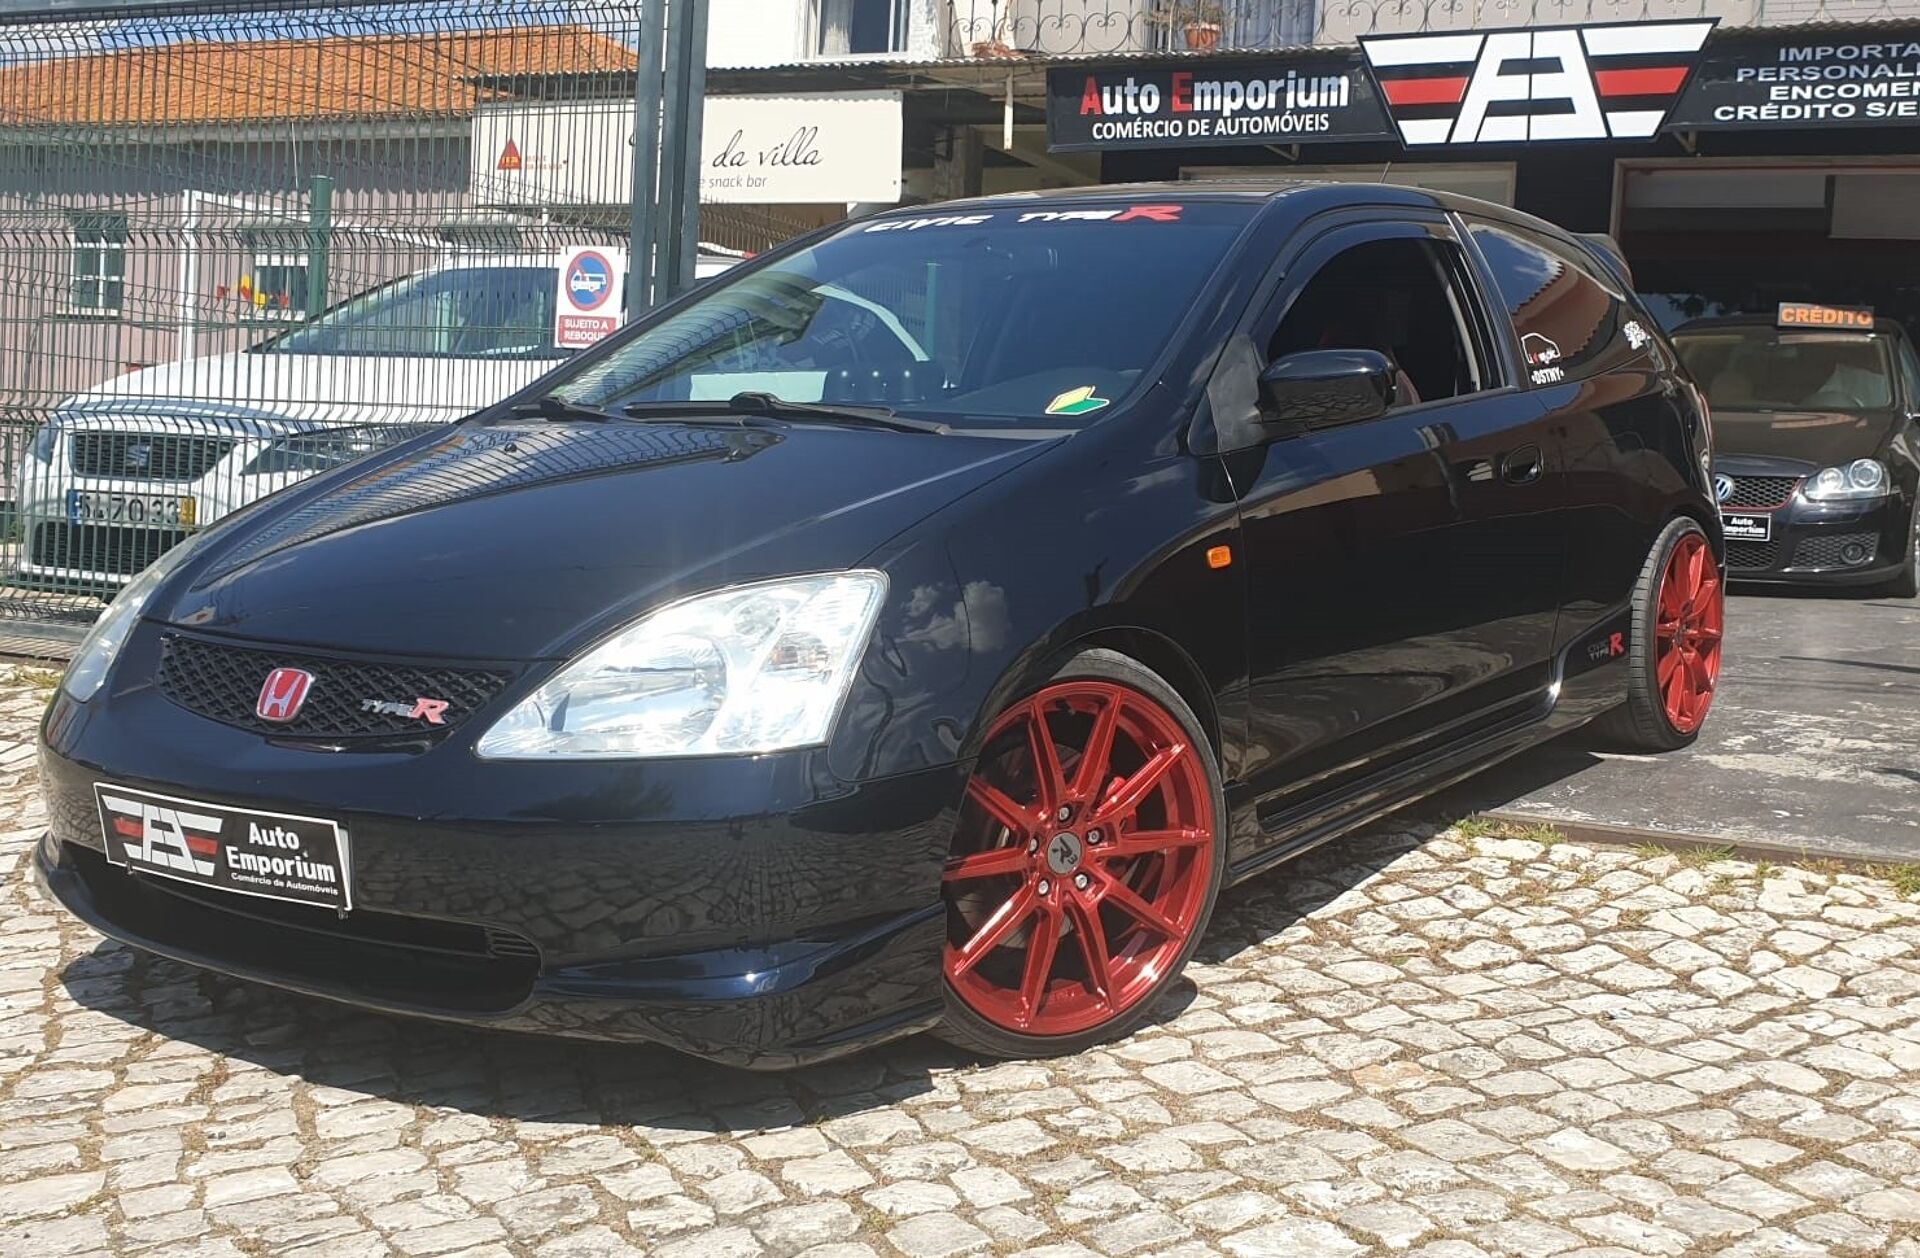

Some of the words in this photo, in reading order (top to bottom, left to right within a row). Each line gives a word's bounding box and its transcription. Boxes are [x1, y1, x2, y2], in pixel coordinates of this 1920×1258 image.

[1080, 76, 1160, 115] Auto
[1172, 71, 1350, 117] Emporium
[1714, 103, 1856, 120] CRÉDITO
[1092, 118, 1182, 139] COMÉRCIO
[1187, 119, 1210, 137] DE
[1214, 110, 1329, 136] AUTOMÓVEIS
[712, 129, 750, 168] da
[758, 126, 824, 167] villa
[709, 174, 743, 188] snack
[747, 174, 768, 188] bar
[864, 214, 994, 232] CIVIC
[564, 318, 599, 329] SUJEITO
[601, 320, 609, 330] A
[1781, 305, 1873, 325] CRÉDITO
[1731, 517, 1754, 526] Auto
[249, 822, 300, 850] Auto
[226, 845, 336, 882] Emporium
[231, 872, 272, 886] Comércio
[273, 879, 285, 887] de
[286, 880, 339, 895] Automóveis
